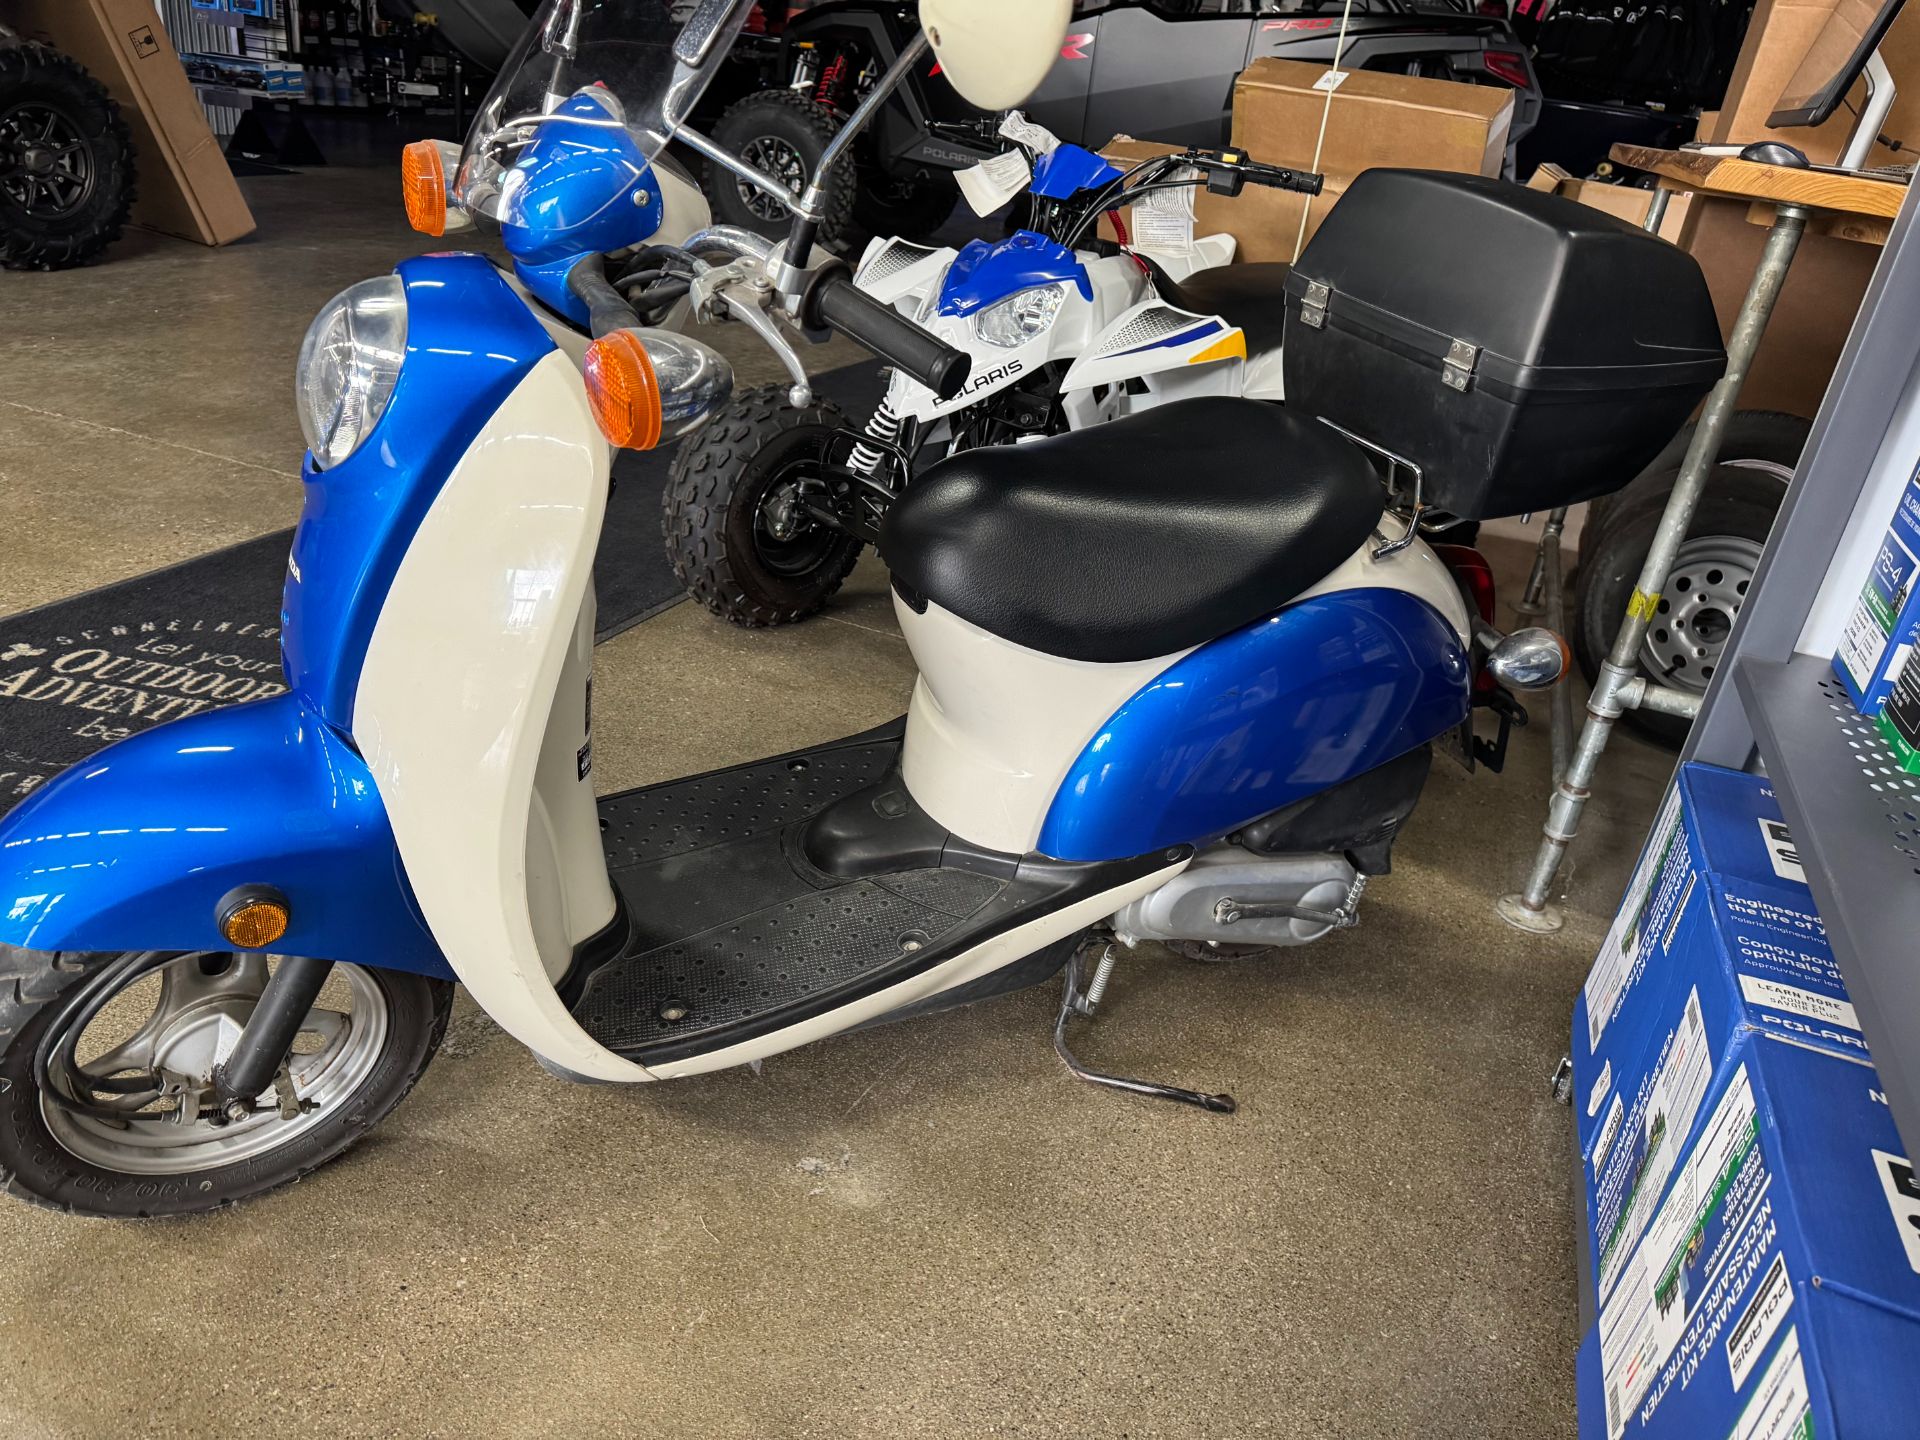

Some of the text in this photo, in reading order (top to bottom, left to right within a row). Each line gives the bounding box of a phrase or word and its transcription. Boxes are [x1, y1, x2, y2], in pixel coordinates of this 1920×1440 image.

[932, 359, 1023, 409] PLARIS
[1877, 545, 1903, 586] PS-4
[135, 636, 282, 673] Let your
[52, 649, 287, 702] OUTDOOR
[1724, 893, 1824, 924] Engineered
[1727, 903, 1813, 930] the life of
[1730, 915, 1765, 928] Polaris
[1767, 923, 1827, 945] Engineering
[1737, 935, 1796, 957] Conçu
[1740, 947, 1843, 980] optimale d
[1804, 974, 1821, 984] par
[1757, 983, 1842, 1011] LEARN MORE
[1761, 1014, 1869, 1050] POLARI
[1721, 1150, 1762, 1227] PRESTATION
[1702, 1163, 1765, 1279] COMPLETE SERVICE
[1703, 1196, 1772, 1322] NÉCESSAIRE
[1680, 1216, 1777, 1393] MAINTENANCE KIT
[1731, 1275, 1788, 1375] POLARIS
[1640, 1310, 1705, 1430] D'ENTRETIEN
